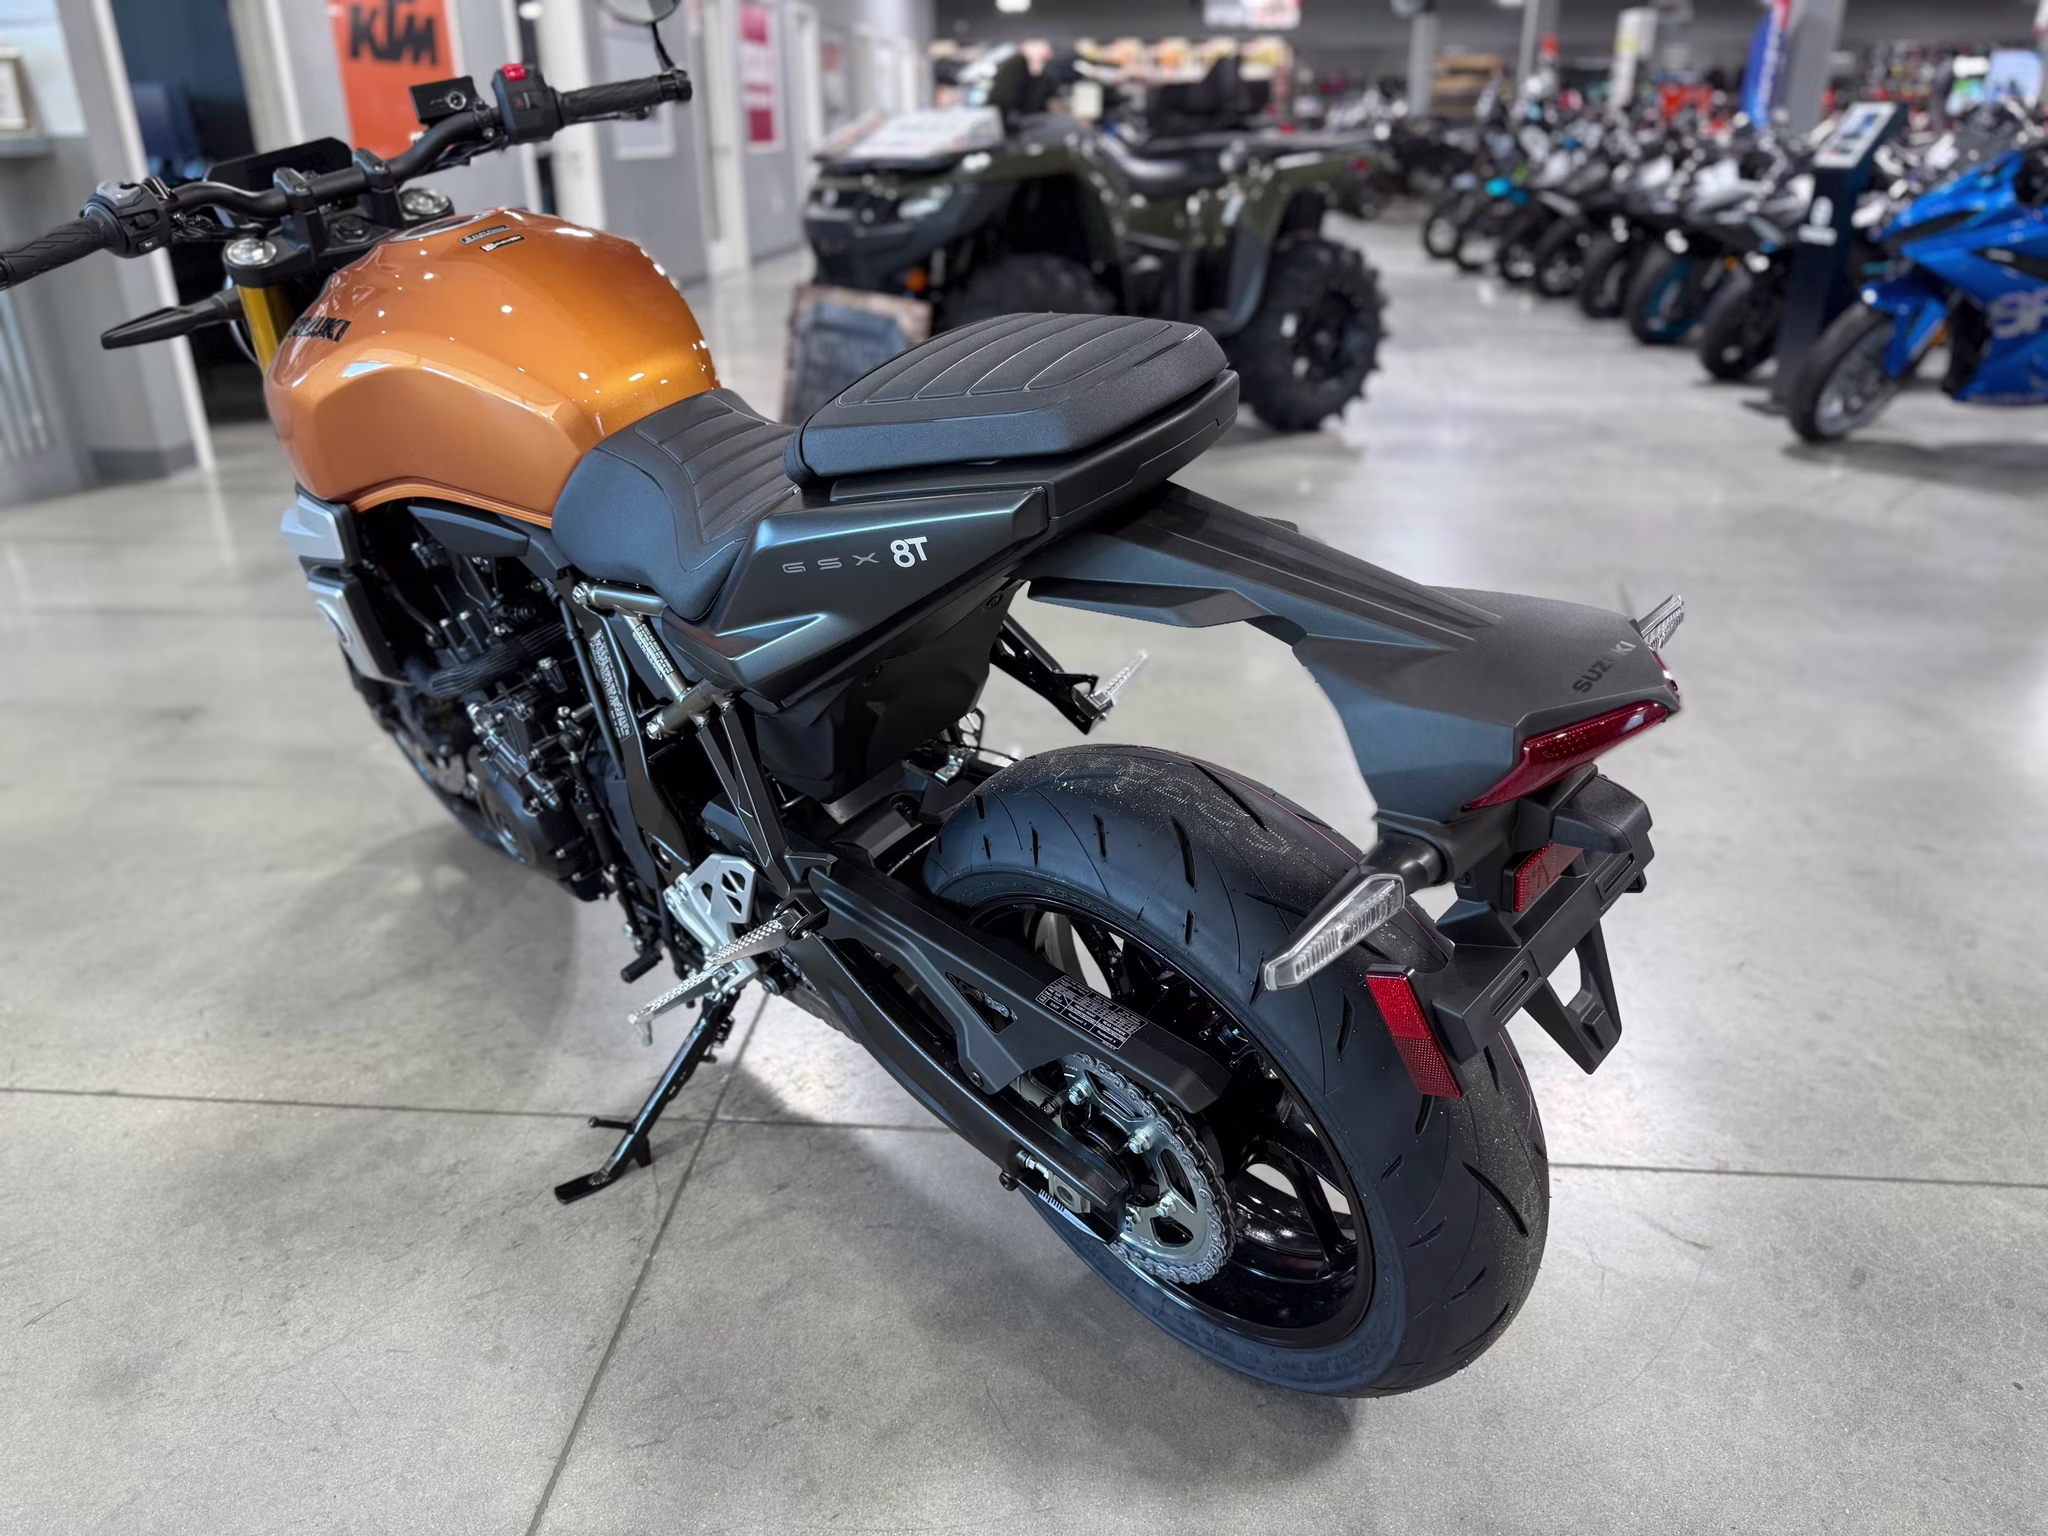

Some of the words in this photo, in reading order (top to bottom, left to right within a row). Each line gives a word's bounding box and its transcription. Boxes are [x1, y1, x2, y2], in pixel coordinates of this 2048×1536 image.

[349, 0, 437, 67] KTM
[782, 552, 880, 574] GSX
[890, 536, 928, 568] 8T
